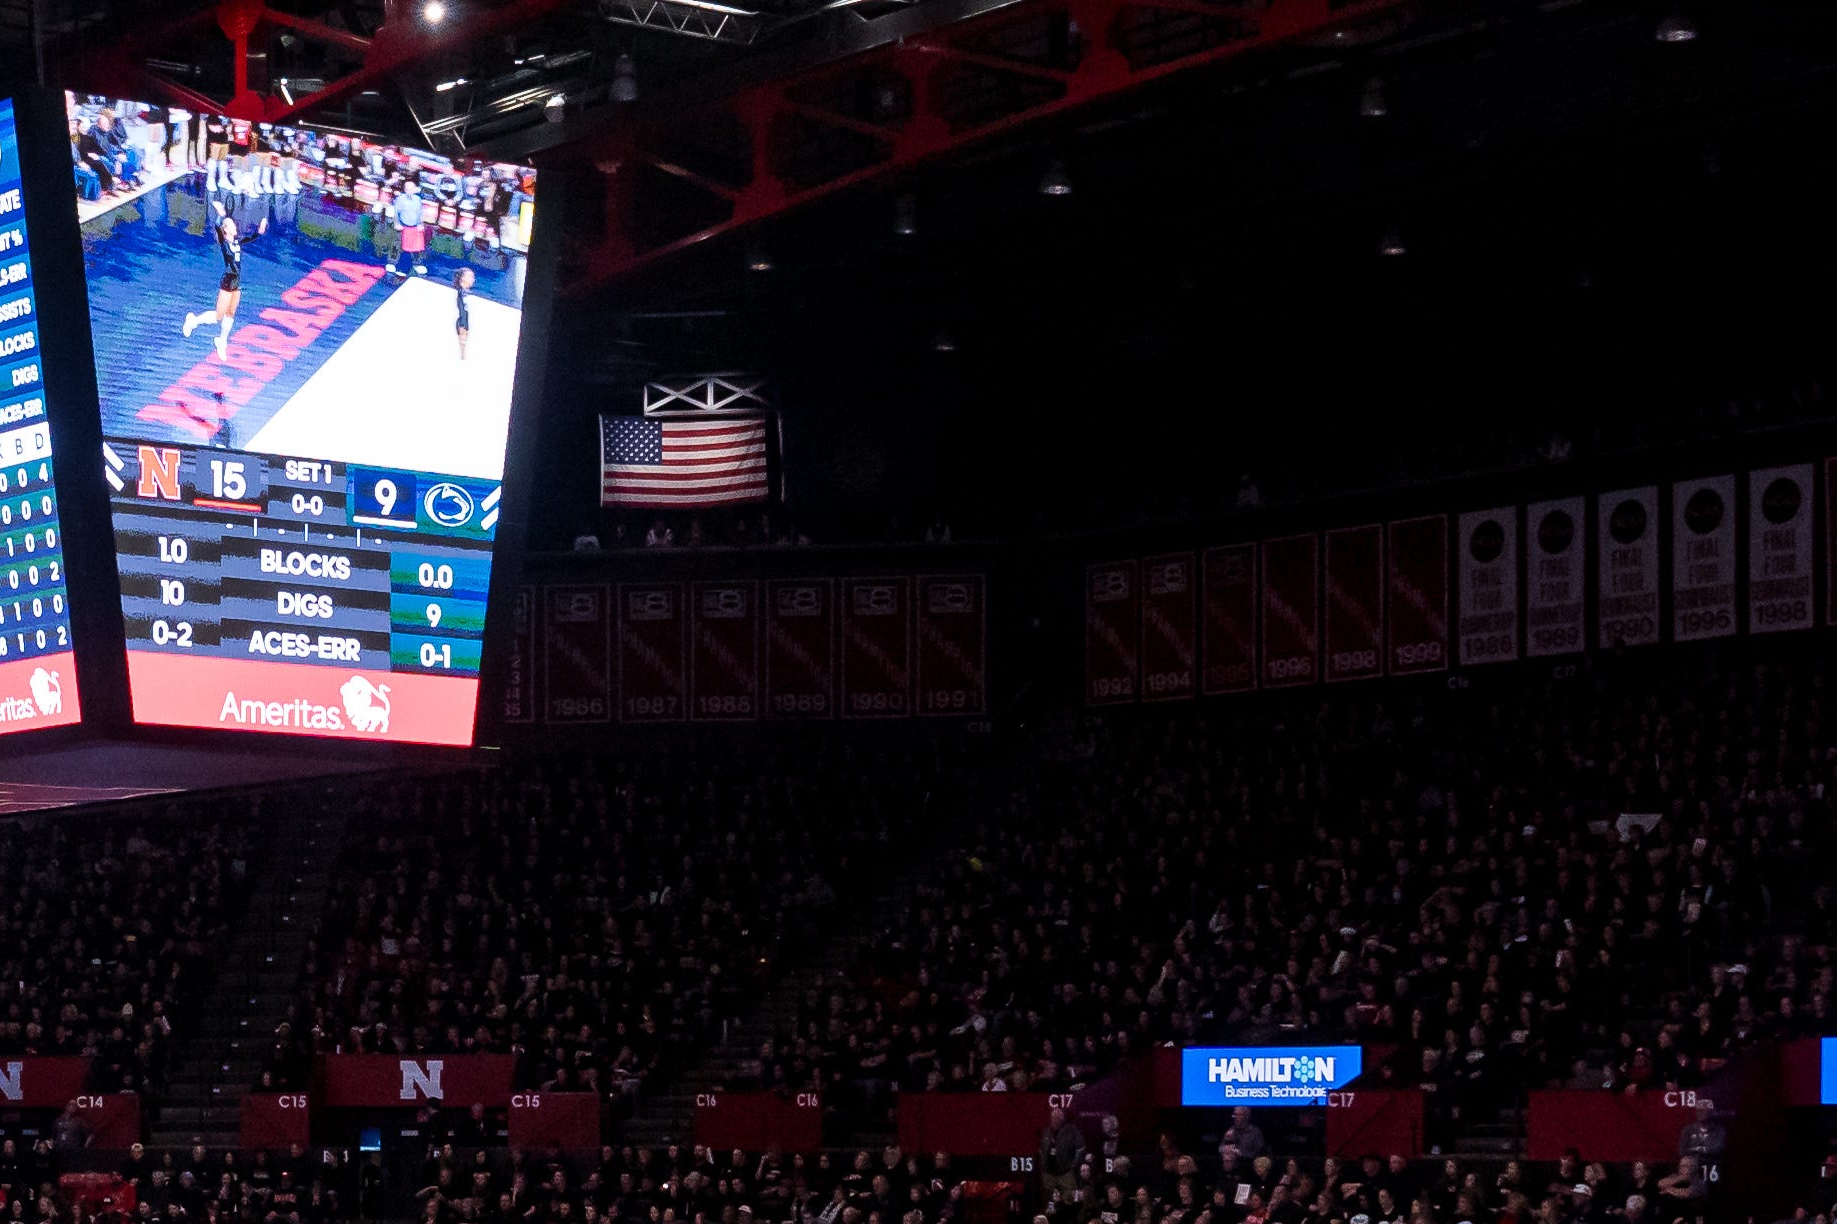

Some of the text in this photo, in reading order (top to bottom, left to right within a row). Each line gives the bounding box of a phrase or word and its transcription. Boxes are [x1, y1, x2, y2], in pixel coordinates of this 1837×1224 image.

[12, 364, 39, 387] DIGS
[0, 398, 43, 426] ACES-ERR
[15, 438, 24, 455] B
[35, 433, 43, 450] D
[17, 468, 28, 488] 0
[38, 463, 48, 483] 4
[137, 446, 247, 500] N 15
[285, 460, 332, 485] SET 1
[1, 505, 12, 525] 0
[21, 500, 32, 520] 0
[42, 495, 52, 515] 0
[291, 493, 323, 516] 0-0
[374, 479, 398, 516] 9
[7, 528, 56, 557] 1 0 0
[9, 570, 19, 589] 0
[29, 565, 39, 585] 0
[49, 561, 59, 581] 2
[158, 537, 454, 590] 1.0 BLOCKS 0.0
[14, 602, 21, 622] 1
[33, 598, 43, 617] 0
[53, 594, 63, 614] 0
[160, 579, 442, 628] 10 DIGS 9
[18, 625, 67, 652] 1 0 2
[152, 621, 451, 669] 0-2 ACES-ERR 0-1
[219, 691, 345, 730] Ameritas
[400, 1059, 443, 1099] N
[1208, 1057, 1336, 1083] HAMILTON
[77, 1095, 103, 1109] C14
[279, 1094, 307, 1109] C15
[511, 1094, 540, 1109] C15
[1048, 1093, 1072, 1109] C17
[1225, 1085, 1329, 1098] Business Technologie
[1328, 1092, 1354, 1109] C17
[1664, 1091, 1696, 1107] C18
[1011, 1157, 1033, 1172] B15
